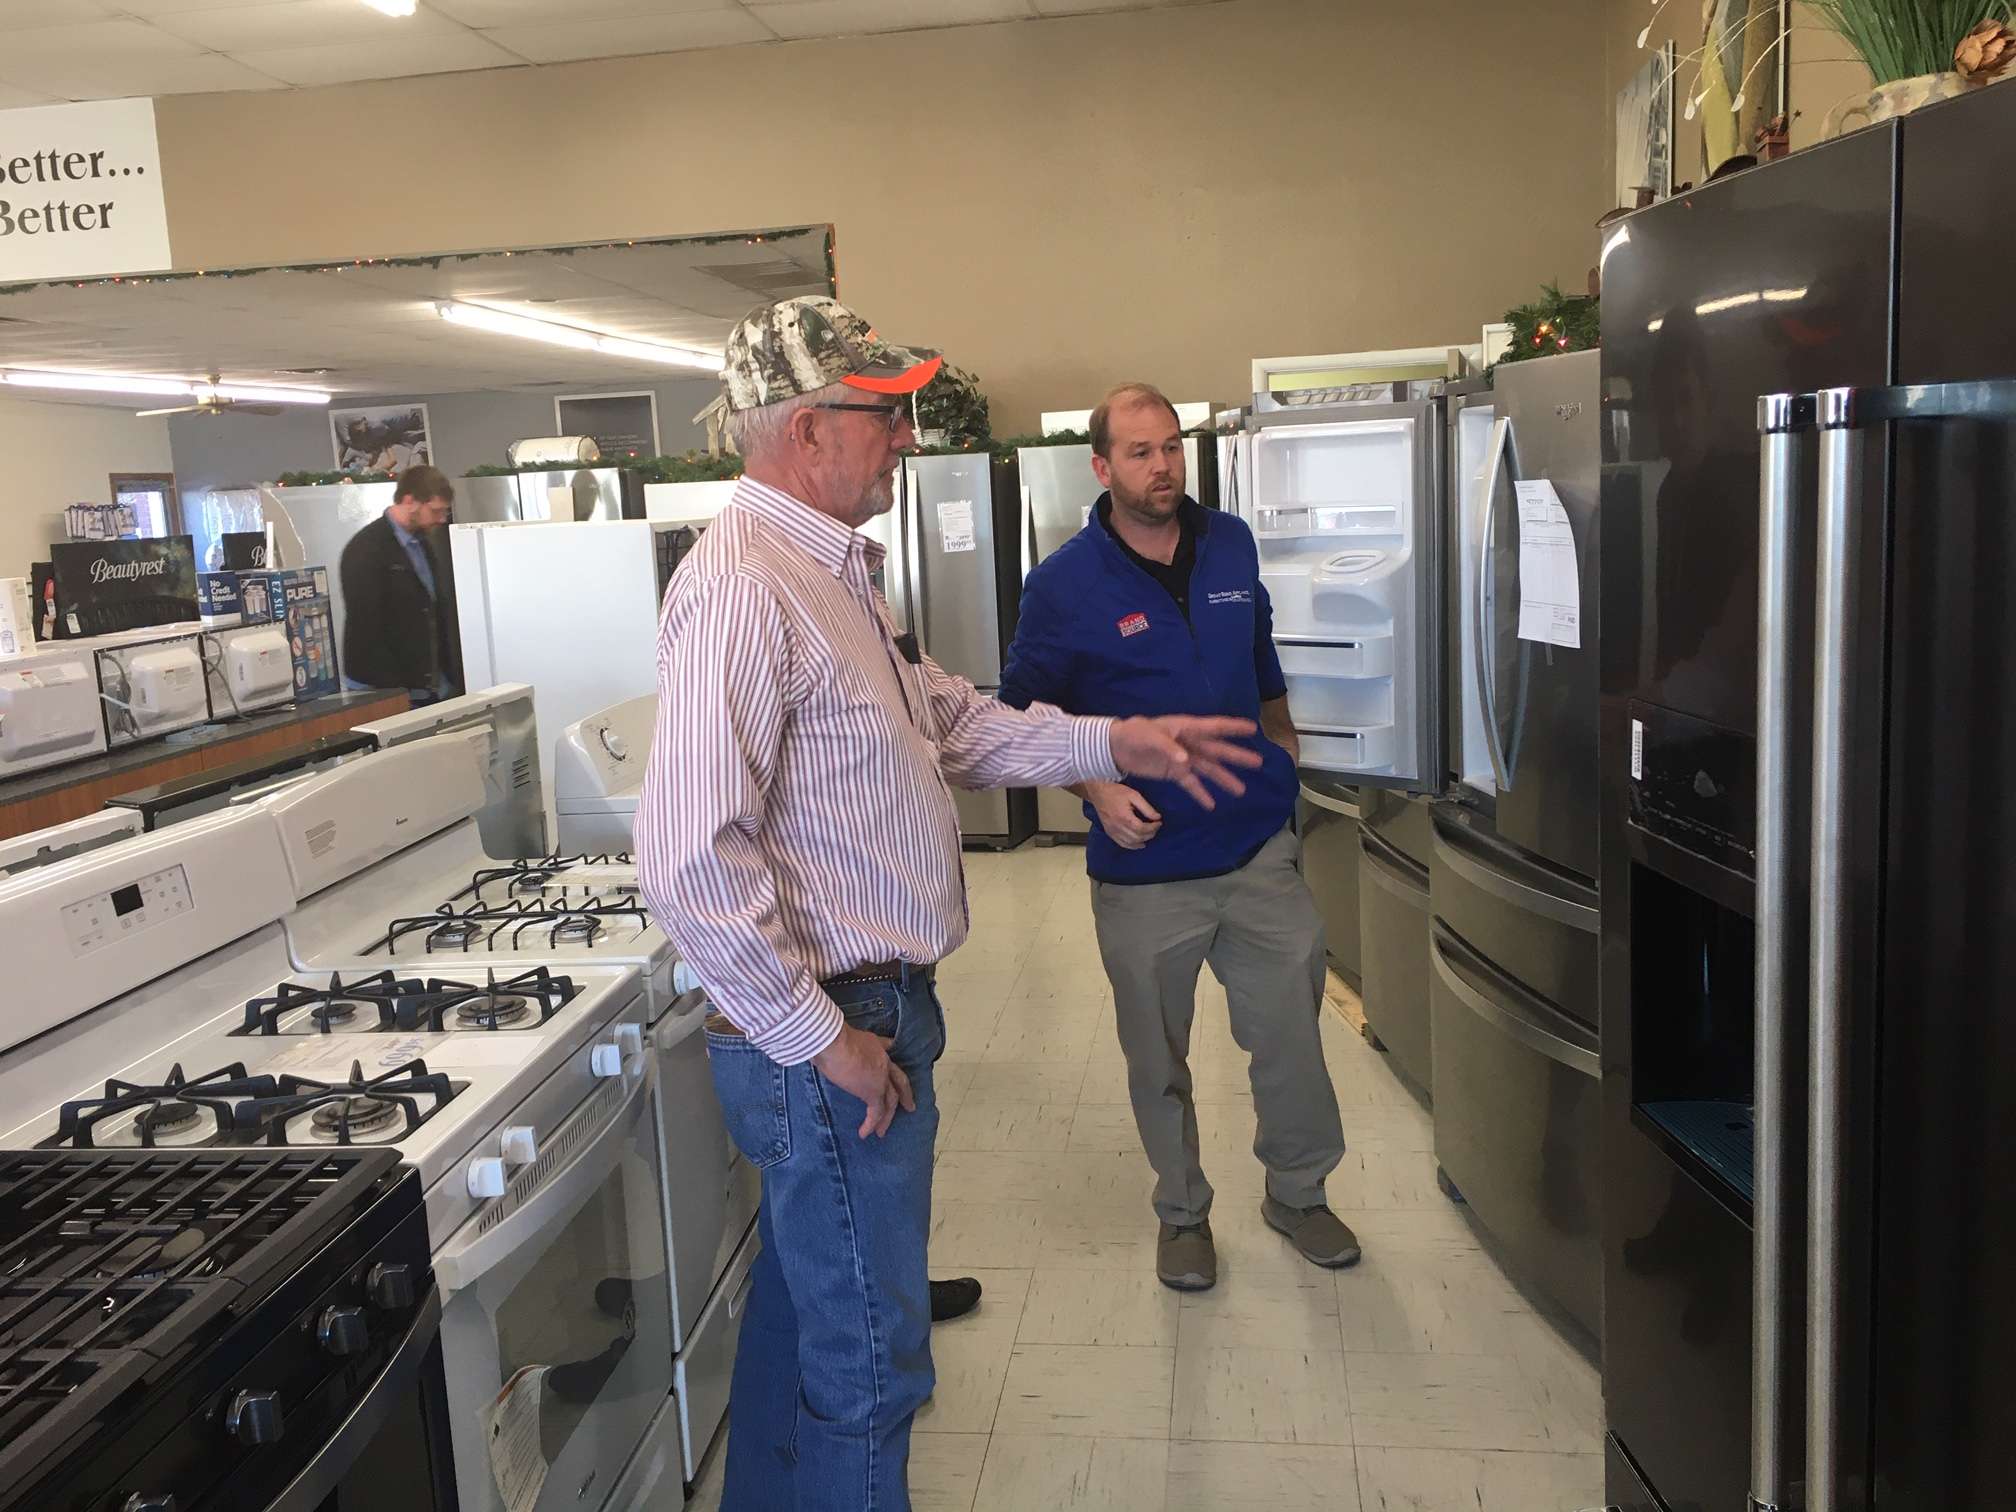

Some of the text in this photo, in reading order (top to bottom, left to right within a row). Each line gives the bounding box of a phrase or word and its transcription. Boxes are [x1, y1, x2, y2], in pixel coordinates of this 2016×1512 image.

[0, 148, 144, 184] etter...
[91, 557, 166, 583] Beautyrest
[211, 586, 231, 595] Credit
[212, 593, 237, 602] Needed
[286, 586, 314, 602] PURE
